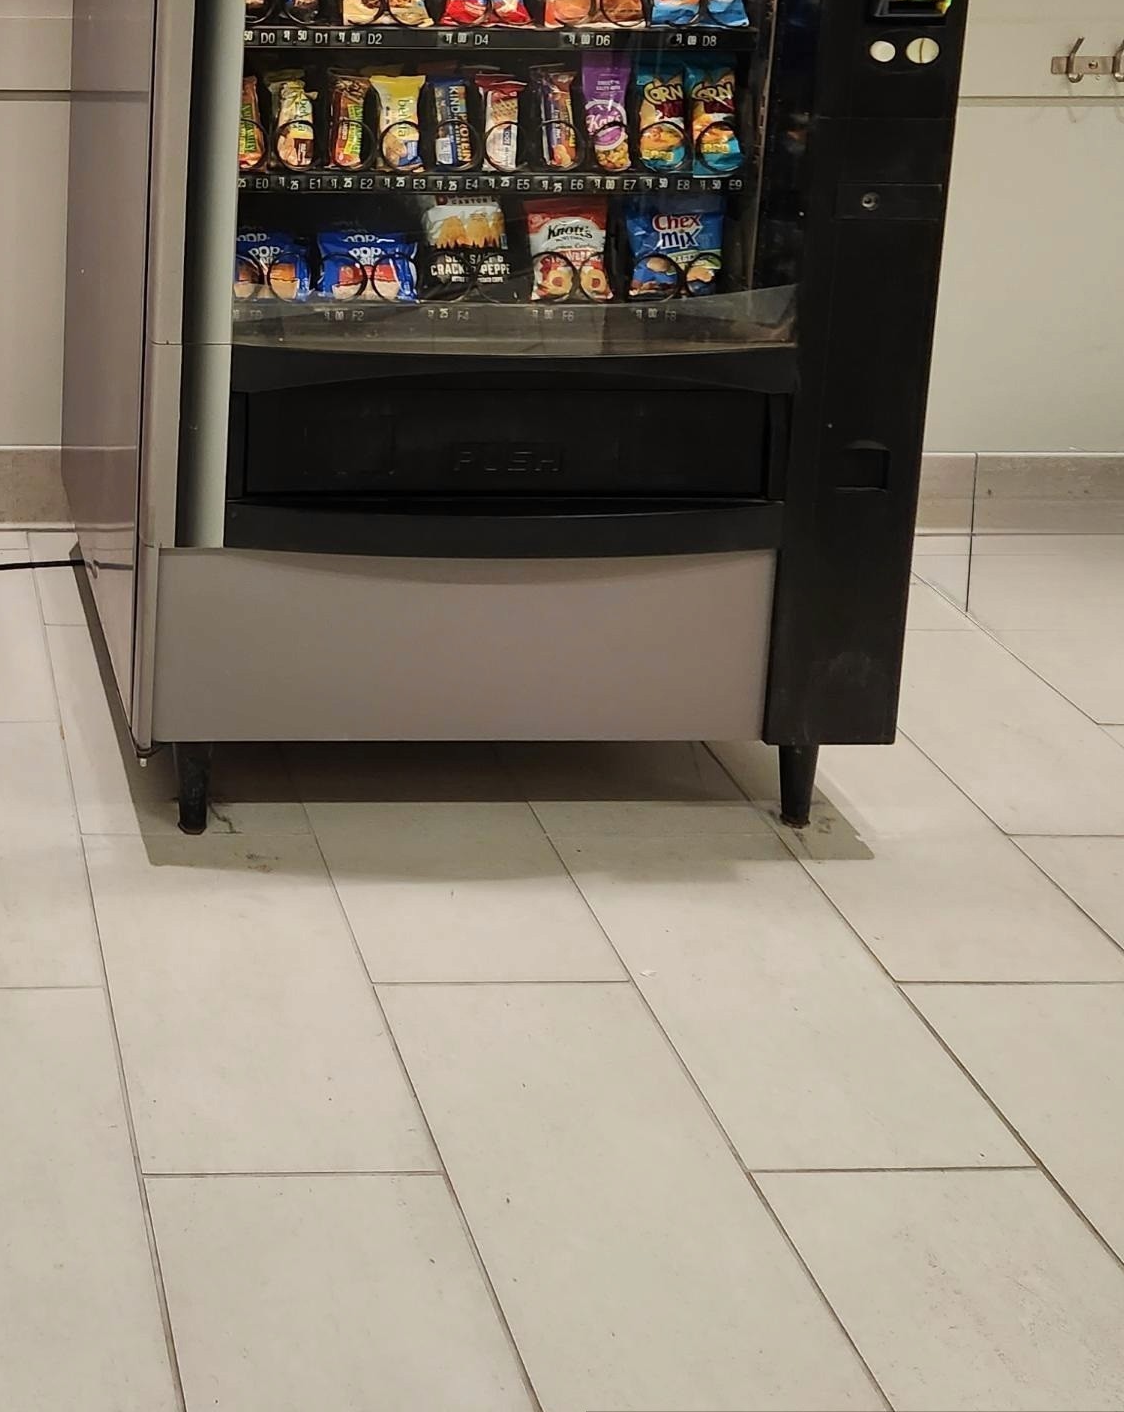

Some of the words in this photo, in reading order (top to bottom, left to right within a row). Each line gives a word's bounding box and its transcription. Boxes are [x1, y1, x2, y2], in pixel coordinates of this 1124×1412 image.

[260, 34, 275, 44] D0
[315, 34, 328, 44] D1
[367, 34, 383, 45] D2
[475, 34, 489, 45] D4
[596, 35, 611, 46] D6
[702, 35, 717, 46] D8
[644, 82, 684, 105] CORN
[449, 86, 460, 113] KIND
[256, 179, 269, 188] E0
[309, 179, 321, 189] E1
[360, 179, 373, 189] E2
[413, 179, 426, 189] E3
[466, 179, 478, 189] E4
[517, 179, 530, 190] E5
[571, 179, 584, 190] E6
[624, 180, 636, 190] E7
[677, 179, 690, 190] E8
[729, 180, 742, 190] E9
[653, 213, 703, 232] Chex
[547, 225, 593, 240] Knott's
[352, 311, 365, 320] F2
[452, 448, 563, 473] PUSH
